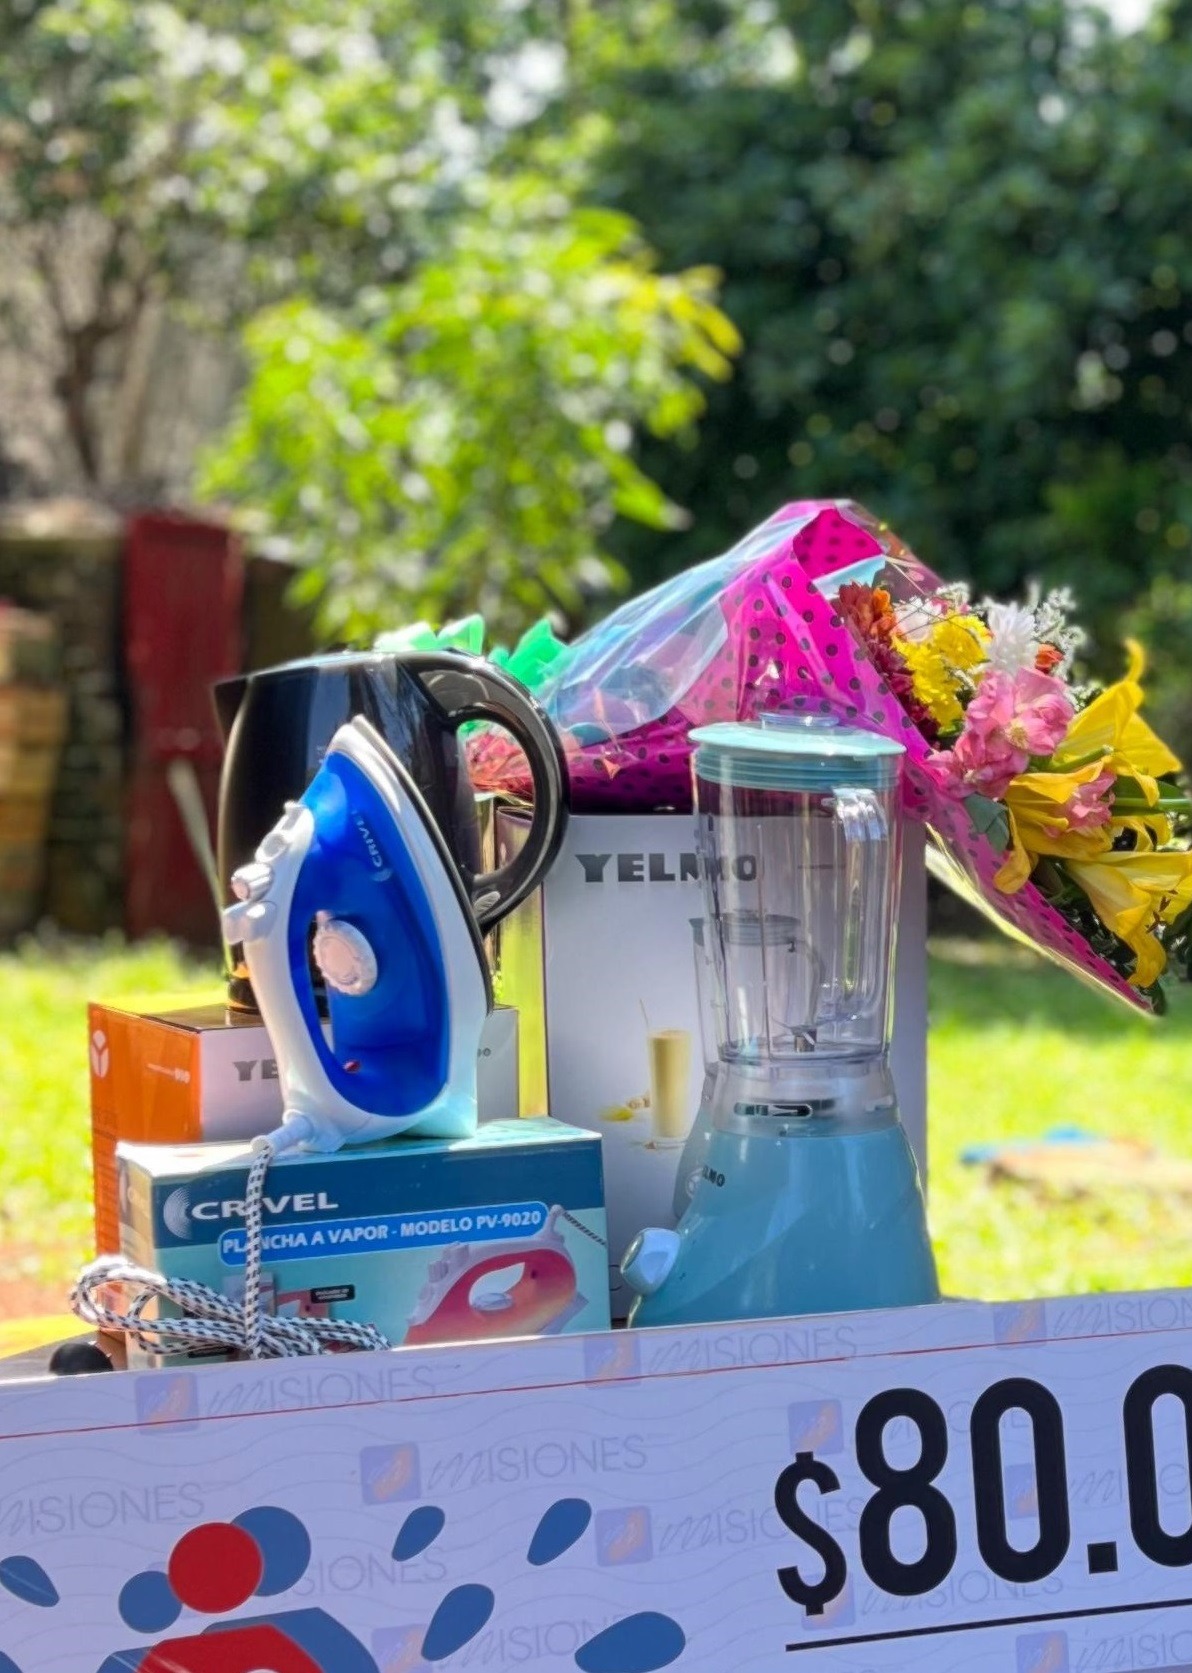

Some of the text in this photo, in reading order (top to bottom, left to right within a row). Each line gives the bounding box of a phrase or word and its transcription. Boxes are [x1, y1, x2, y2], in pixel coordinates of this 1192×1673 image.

[191, 1192, 339, 1220] CRVEL
[311, 1230, 325, 1246] A
[327, 1224, 388, 1244] VAPOR
[400, 1217, 473, 1238] MODELO
[476, 1210, 542, 1230] PV-9020
